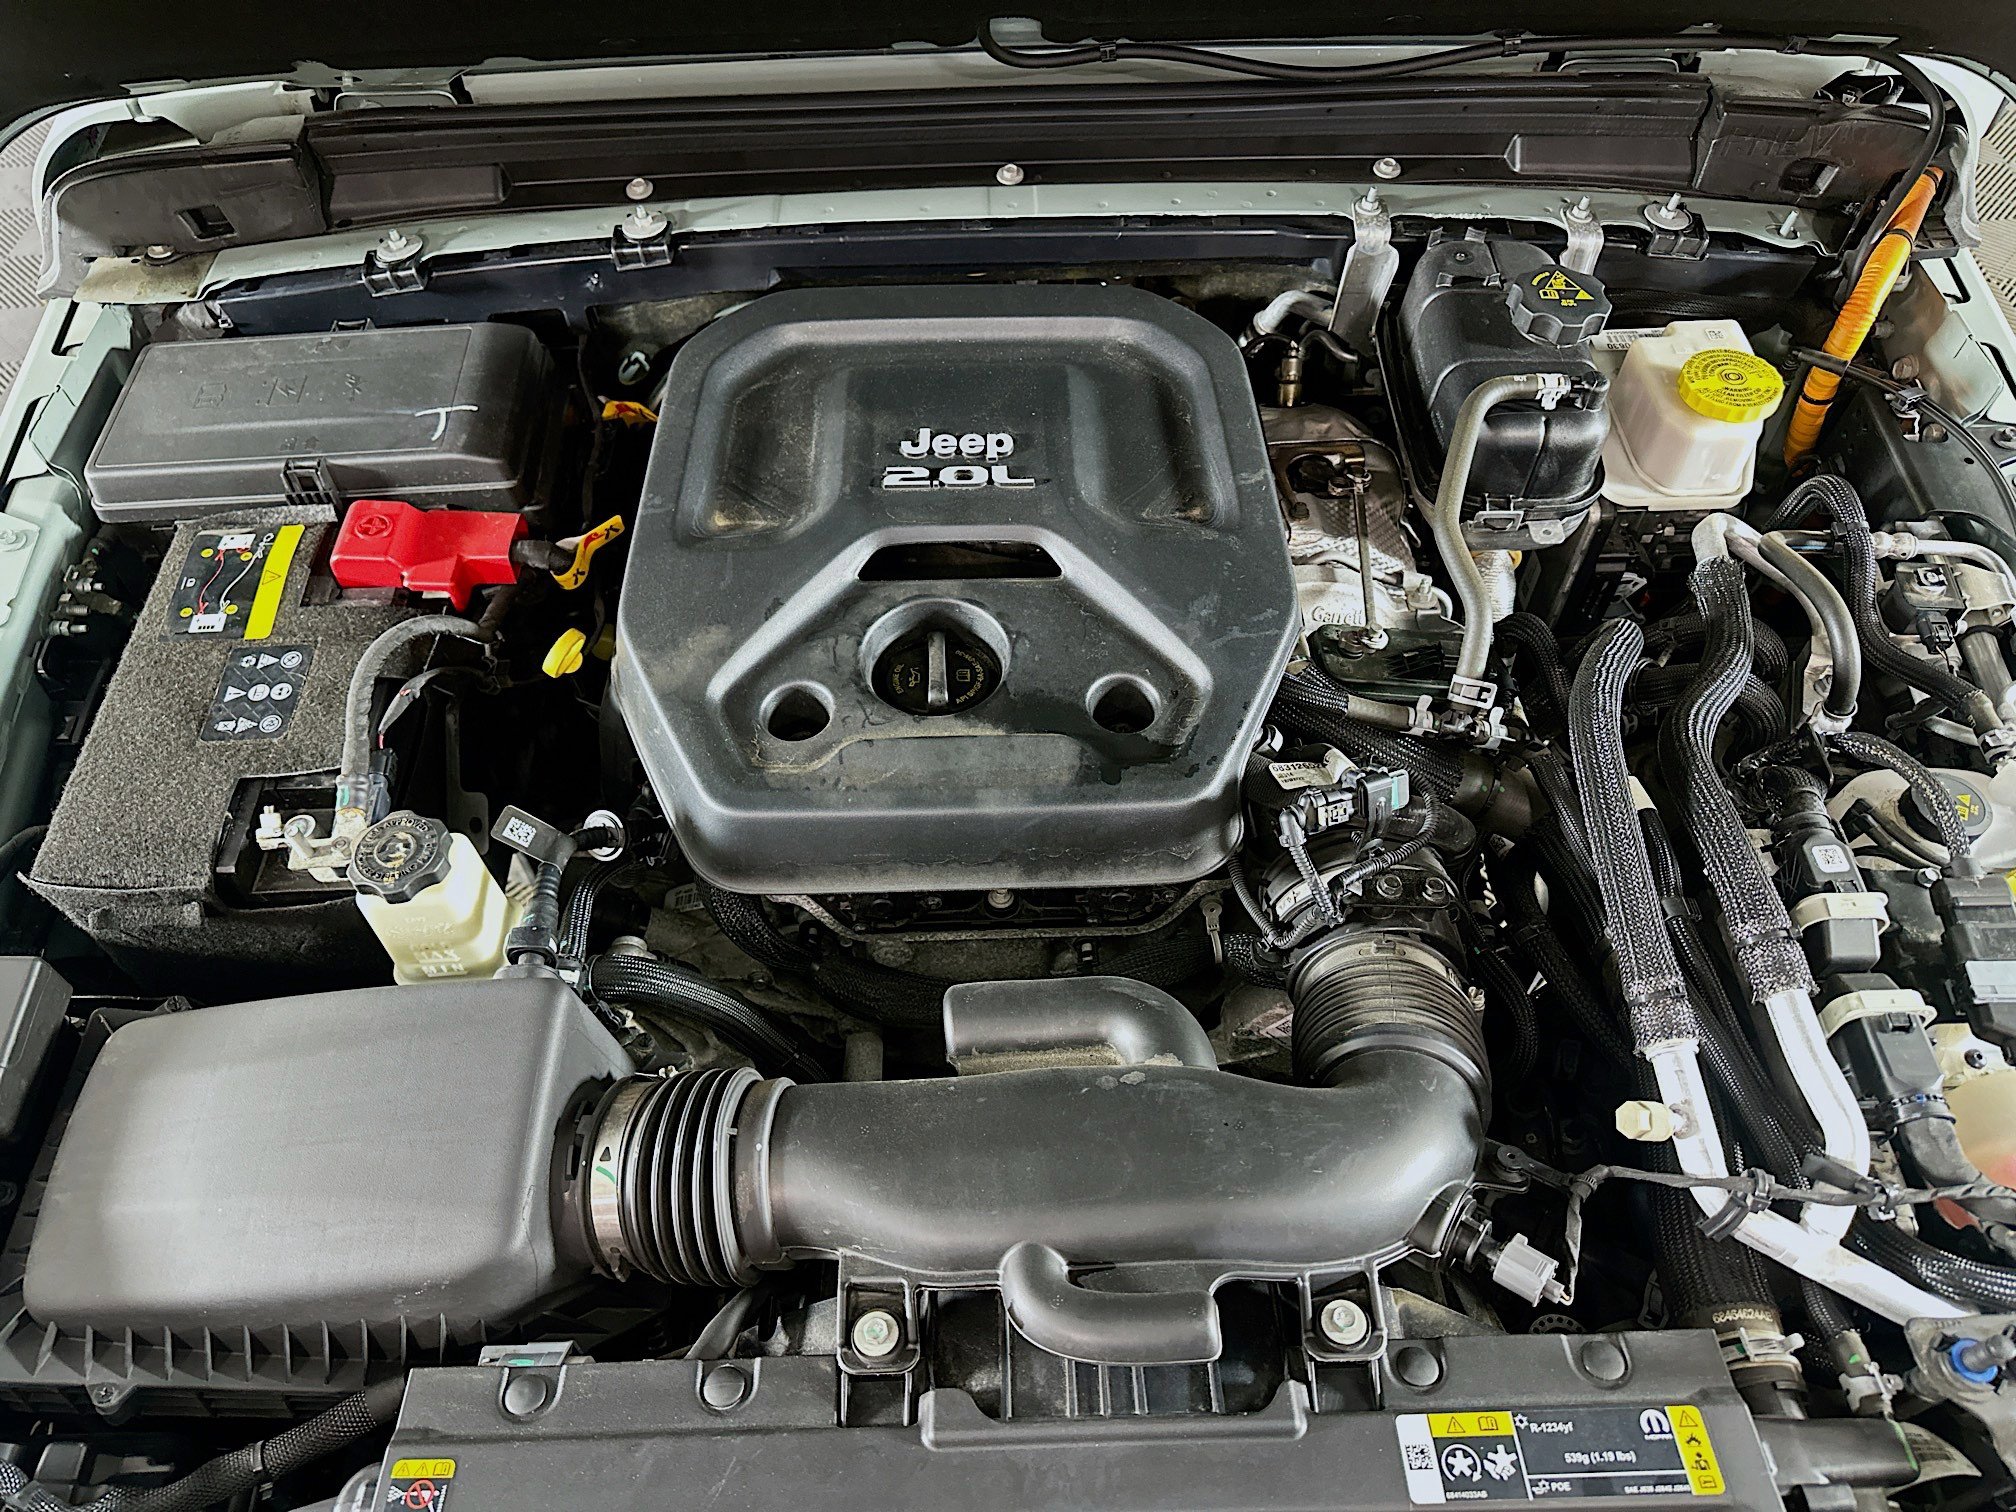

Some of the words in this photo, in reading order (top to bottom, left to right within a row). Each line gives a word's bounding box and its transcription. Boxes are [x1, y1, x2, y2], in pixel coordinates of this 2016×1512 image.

[899, 427, 1015, 463] Jeep
[881, 465, 1036, 490] 2.0L
[1311, 605, 1363, 625] Garrett
[1530, 1421, 1574, 1435] R-1234yf
[1564, 1452, 1590, 1465] 539g
[1590, 1452, 1616, 1465] (1.19
[1616, 1450, 1636, 1463] lbs)
[1551, 1481, 1572, 1492] POE
